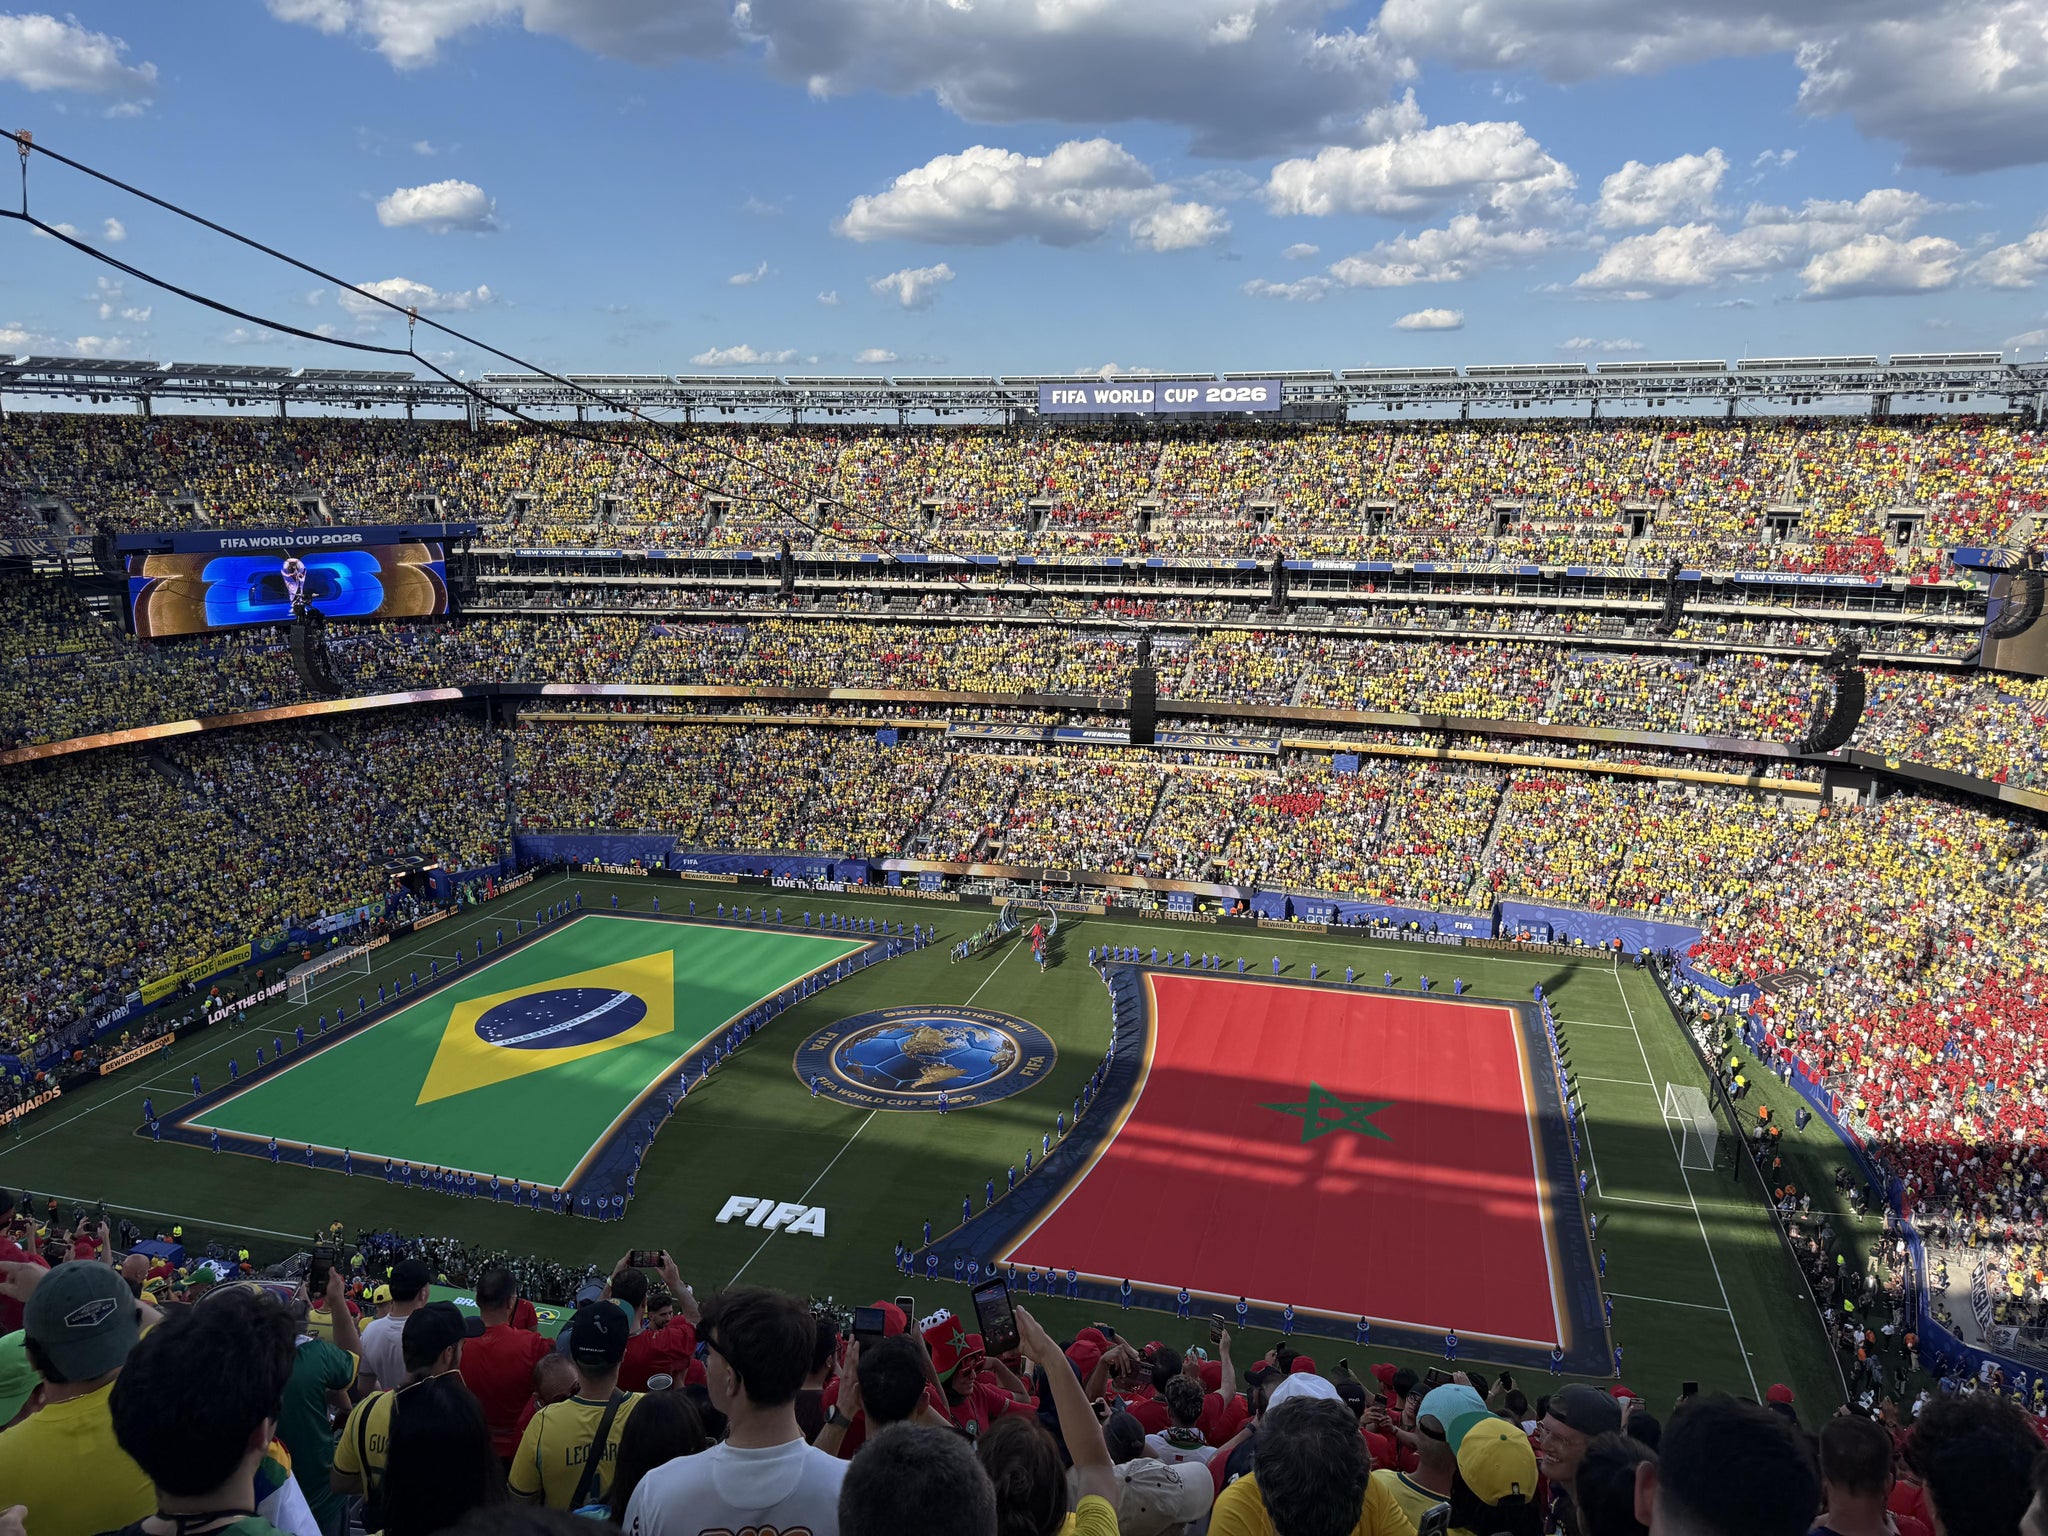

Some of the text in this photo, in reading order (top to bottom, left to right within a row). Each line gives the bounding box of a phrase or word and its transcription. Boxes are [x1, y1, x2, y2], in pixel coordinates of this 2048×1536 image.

[1052, 387, 1267, 404] FIFA WORLD CUP 2026
[220, 533, 363, 549] FIFA WORLD CUP 2026
[1740, 573, 1765, 581] NEW
[1768, 574, 1799, 582] YORK
[1801, 575, 1826, 583] NEW
[582, 863, 648, 876] FIFA REWARDS
[685, 873, 734, 882] REWARDS.FIFA.COM
[500, 873, 534, 895] REWARDS
[771, 878, 796, 889] LOVE
[816, 882, 844, 893] GAME
[847, 884, 888, 897] REWARD
[889, 887, 916, 899] YOUR
[917, 890, 960, 902] PASSION
[1062, 904, 1090, 912] JERSEY
[1139, 909, 1217, 924] FIFA REWARDS
[1262, 921, 1323, 932] REWARDS.FIFA.COM
[1455, 921, 1473, 931] FIFA
[1370, 929, 1612, 960] LOVE THE GAME REWARD YOUR PASSION
[217, 951, 250, 967] AMARELO
[236, 994, 257, 1012] THE
[257, 980, 287, 1001] GAME
[502, 1017, 585, 1046] PROGRESSO
[808, 1031, 838, 1052] FIFA
[105, 1037, 170, 1071] REWARDS.FIFA.COM
[1019, 1055, 1046, 1077] FIFA
[817, 1076, 841, 1093] FIFA
[838, 1086, 885, 1105] WORLD
[886, 1098, 919, 1107] CUP
[715, 1195, 826, 1238] FIFA
